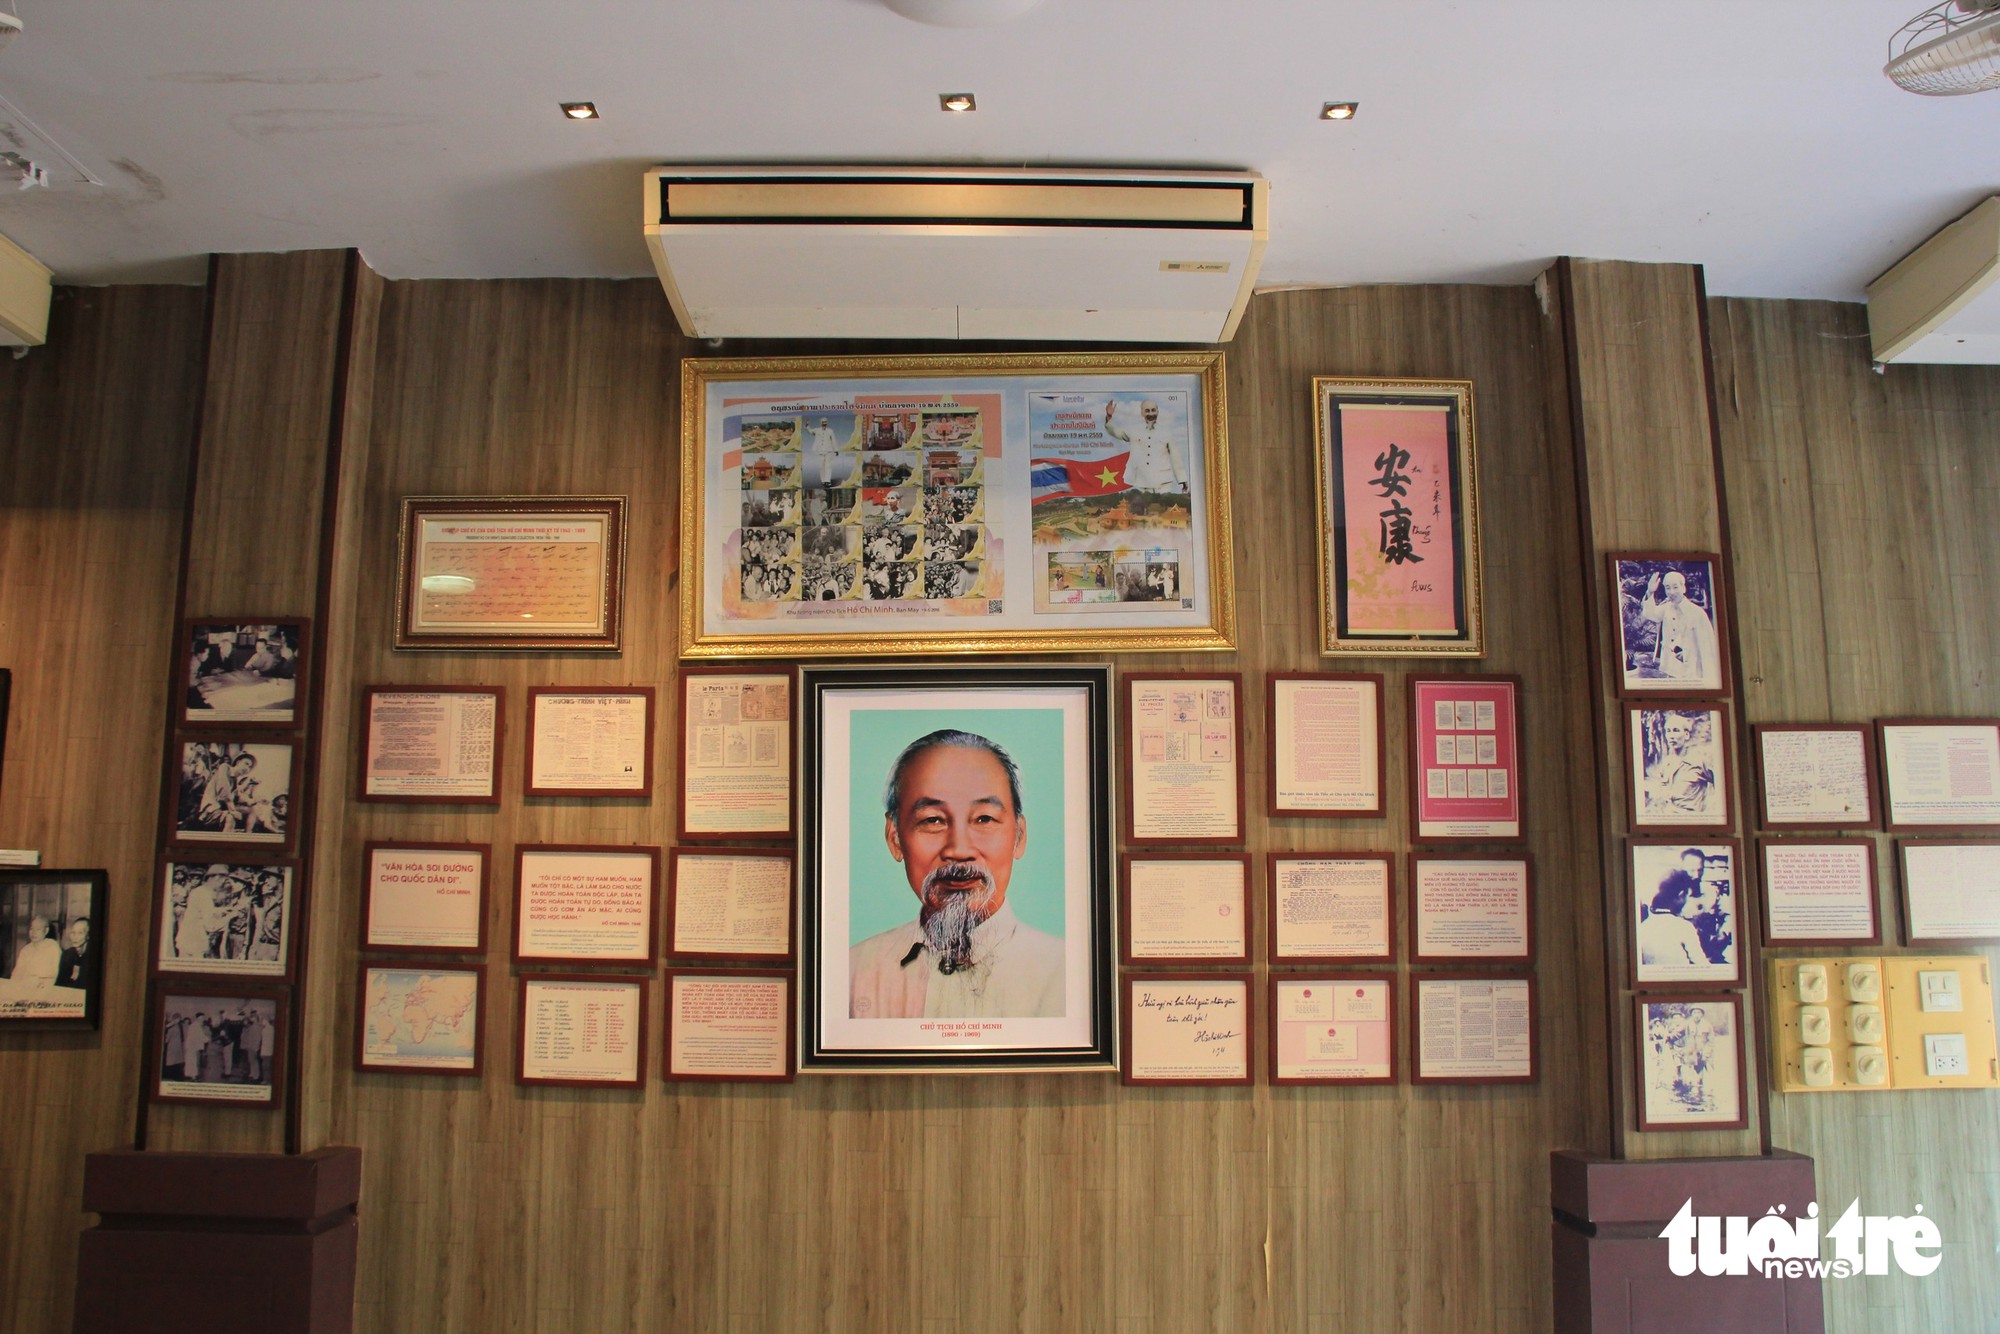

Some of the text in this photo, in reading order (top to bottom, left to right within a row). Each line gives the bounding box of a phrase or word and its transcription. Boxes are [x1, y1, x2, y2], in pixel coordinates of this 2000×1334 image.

[1368, 443, 1424, 565] 安康
[380, 874, 399, 882] CHO
[920, 1022, 935, 1030] CHỦ
[956, 1021, 965, 1030] HỒ
